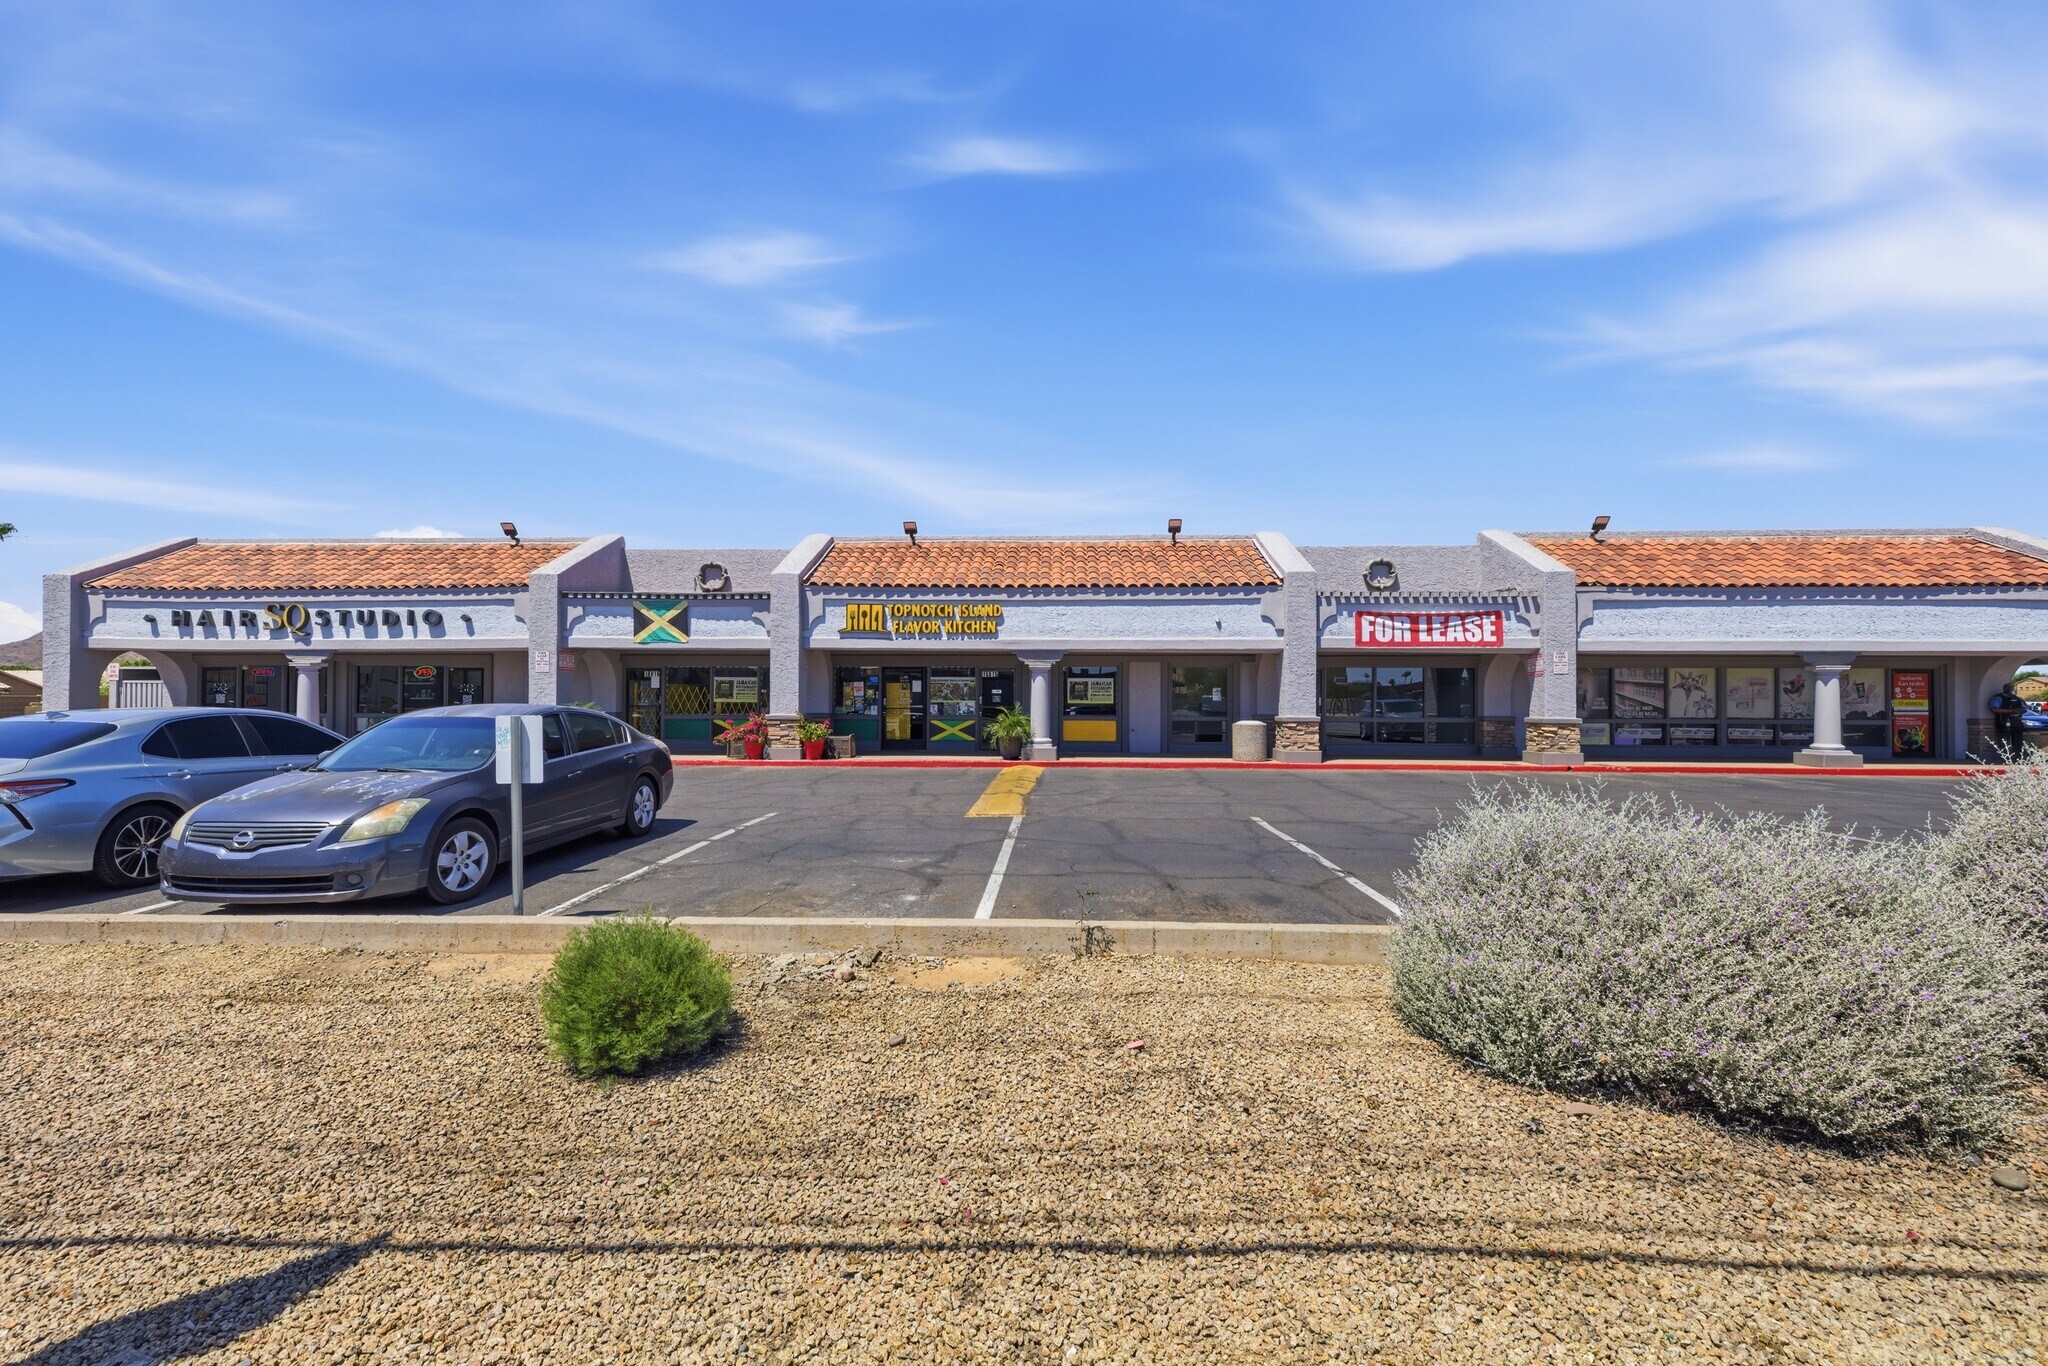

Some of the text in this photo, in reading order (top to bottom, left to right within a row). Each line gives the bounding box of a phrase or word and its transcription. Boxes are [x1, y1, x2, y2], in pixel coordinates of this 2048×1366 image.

[887, 603, 1003, 617] TOPNOTCH ISLAND
[171, 603, 443, 637] HAIR SQ STUDIO
[892, 620, 996, 634] FLAVOR KITCHEN
[1361, 615, 1498, 643] FOR LEASE
[416, 667, 434, 677] OPEN
